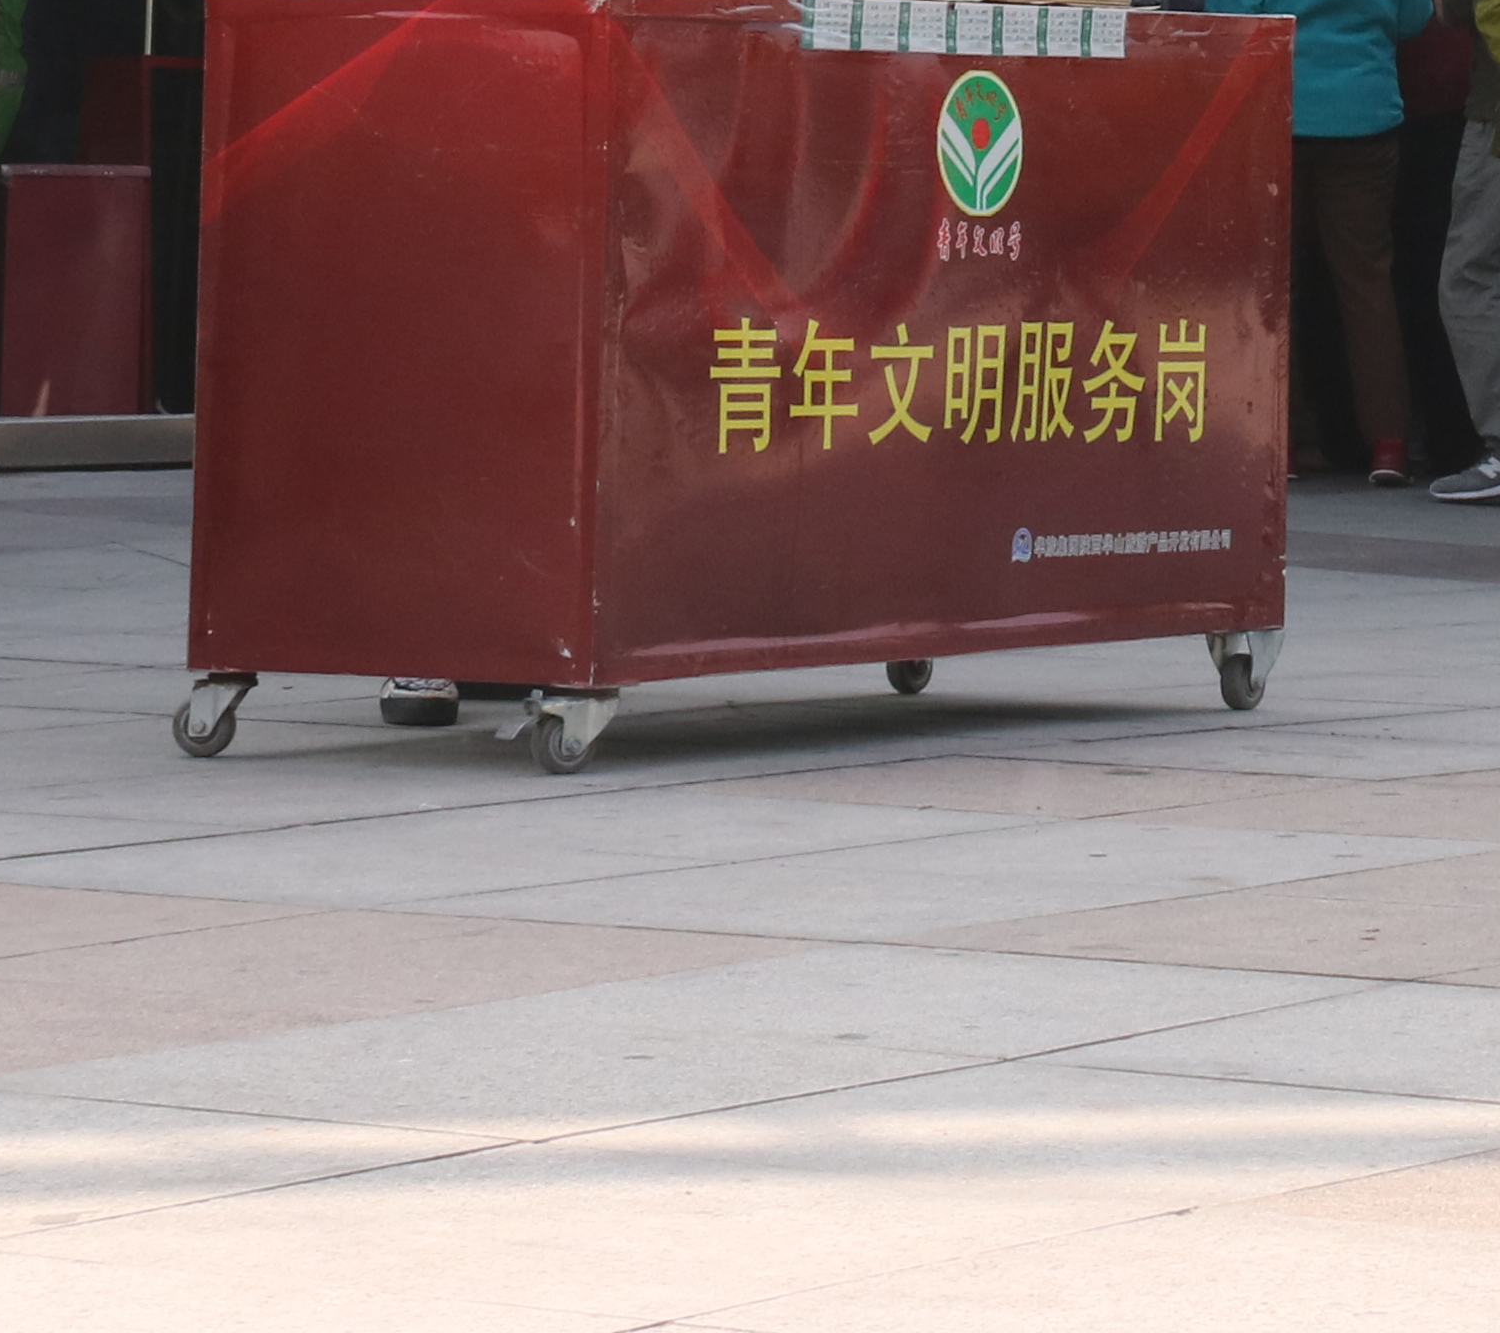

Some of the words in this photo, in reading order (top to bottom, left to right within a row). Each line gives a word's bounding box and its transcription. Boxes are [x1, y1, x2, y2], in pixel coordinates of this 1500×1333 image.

[709, 316, 1207, 455] 青年文明服务岗
